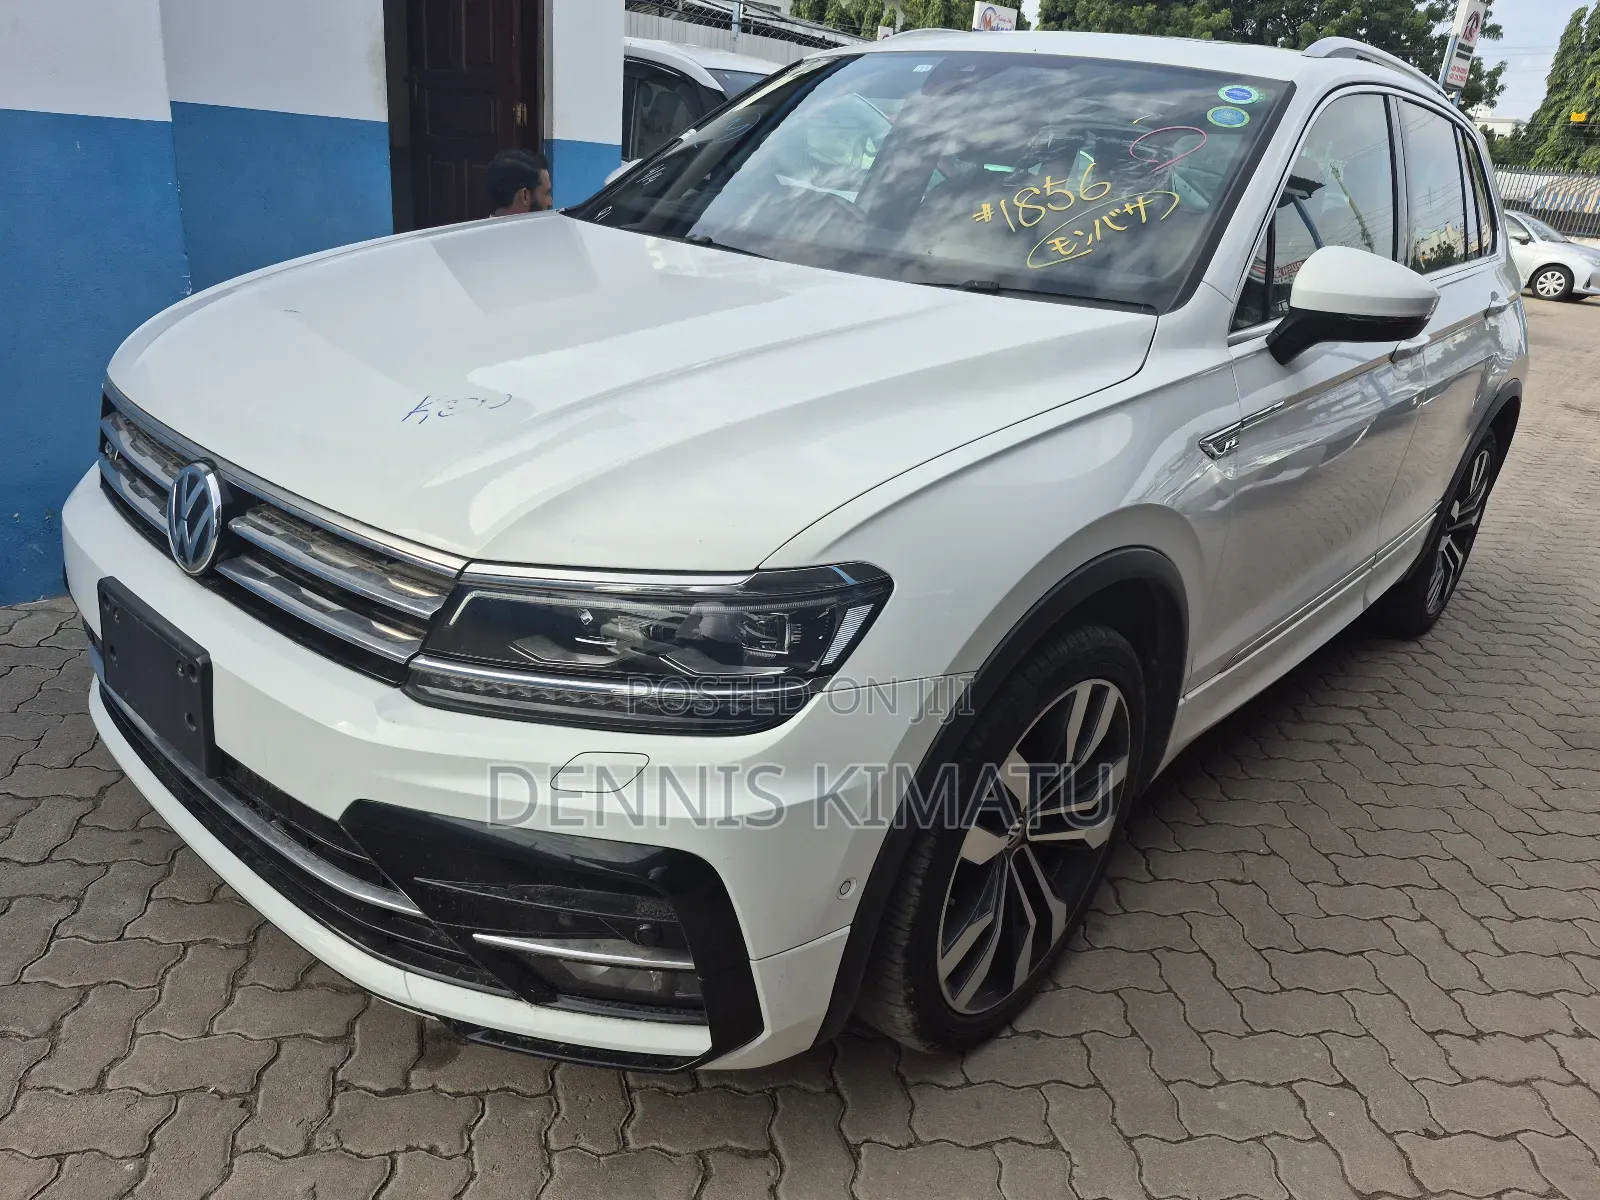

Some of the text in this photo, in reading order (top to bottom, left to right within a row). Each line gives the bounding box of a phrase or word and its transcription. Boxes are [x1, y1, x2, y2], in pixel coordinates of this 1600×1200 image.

[972, 163, 1112, 233] #1856
[1046, 196, 1154, 255] モンバサ
